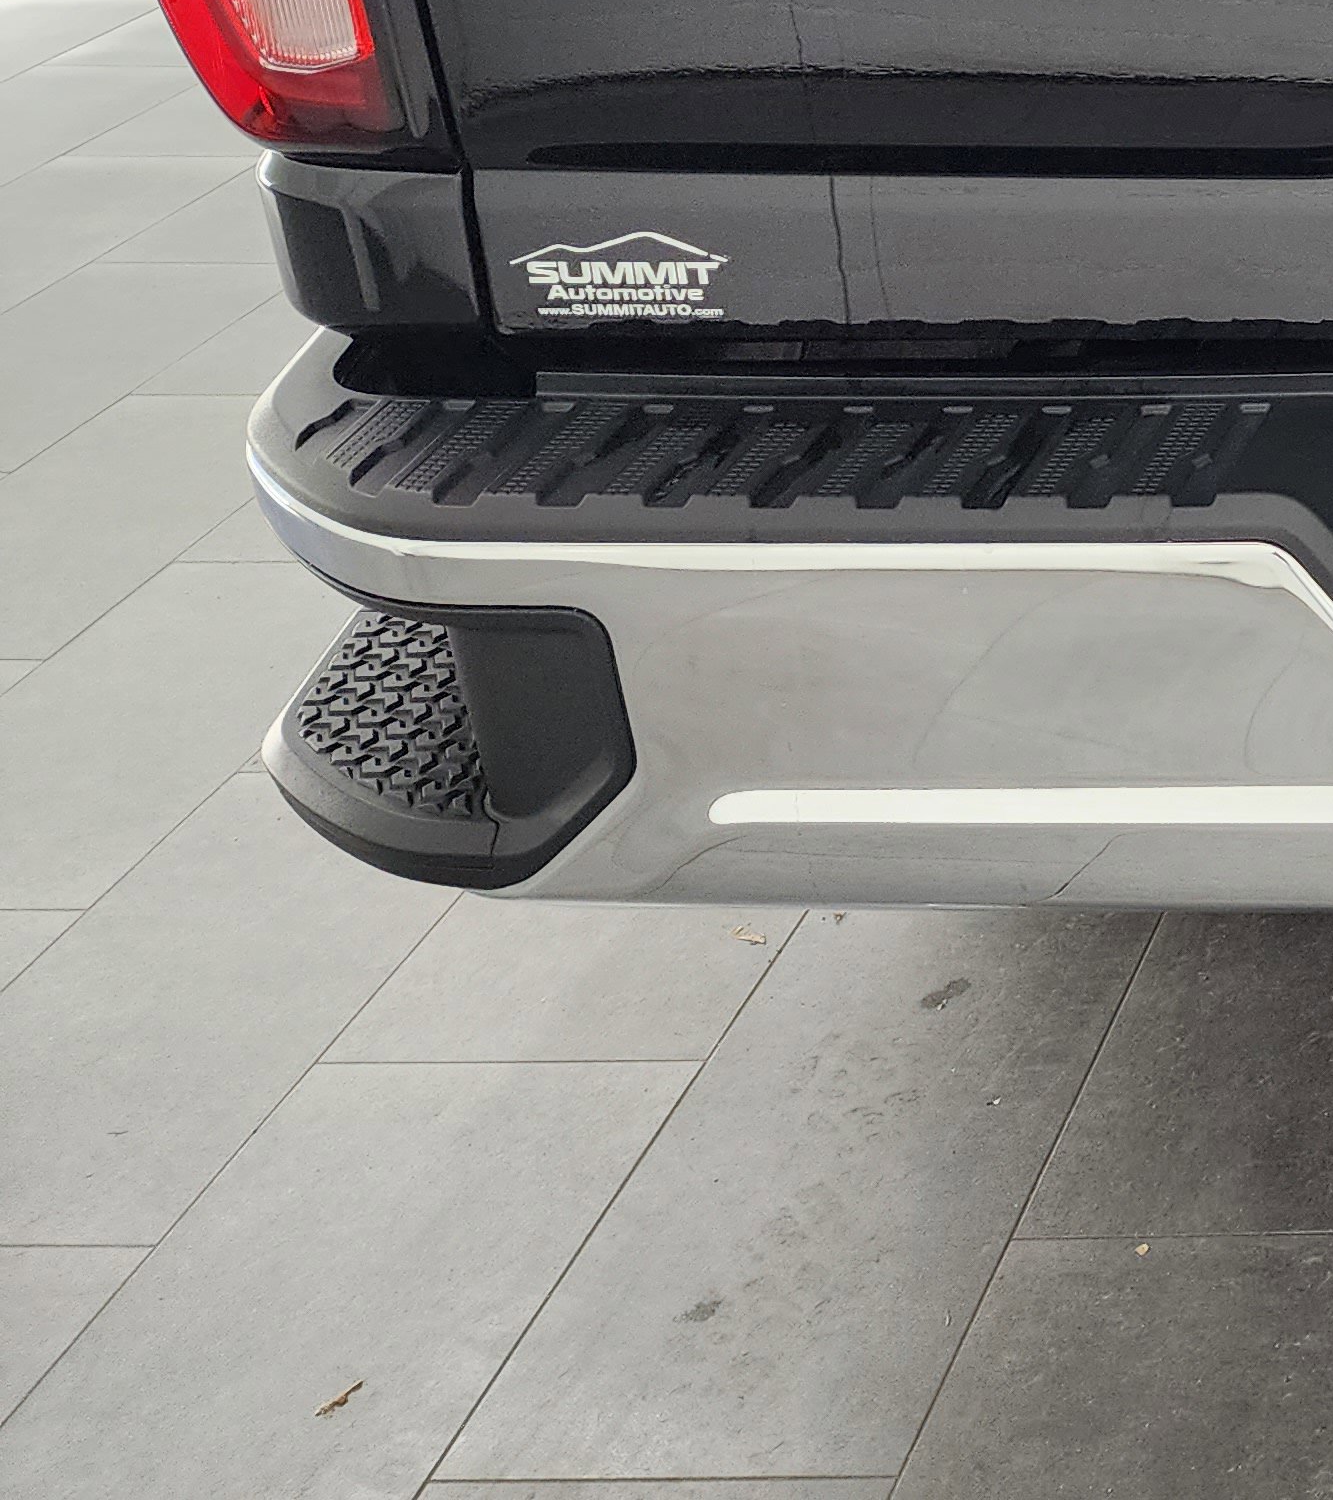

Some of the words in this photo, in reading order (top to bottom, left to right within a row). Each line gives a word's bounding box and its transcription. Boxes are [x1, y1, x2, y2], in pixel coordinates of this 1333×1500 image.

[526, 261, 720, 285] SUMMIT
[547, 284, 704, 301] Automotive
[538, 303, 724, 317] www.SUMMITAUTO.com
